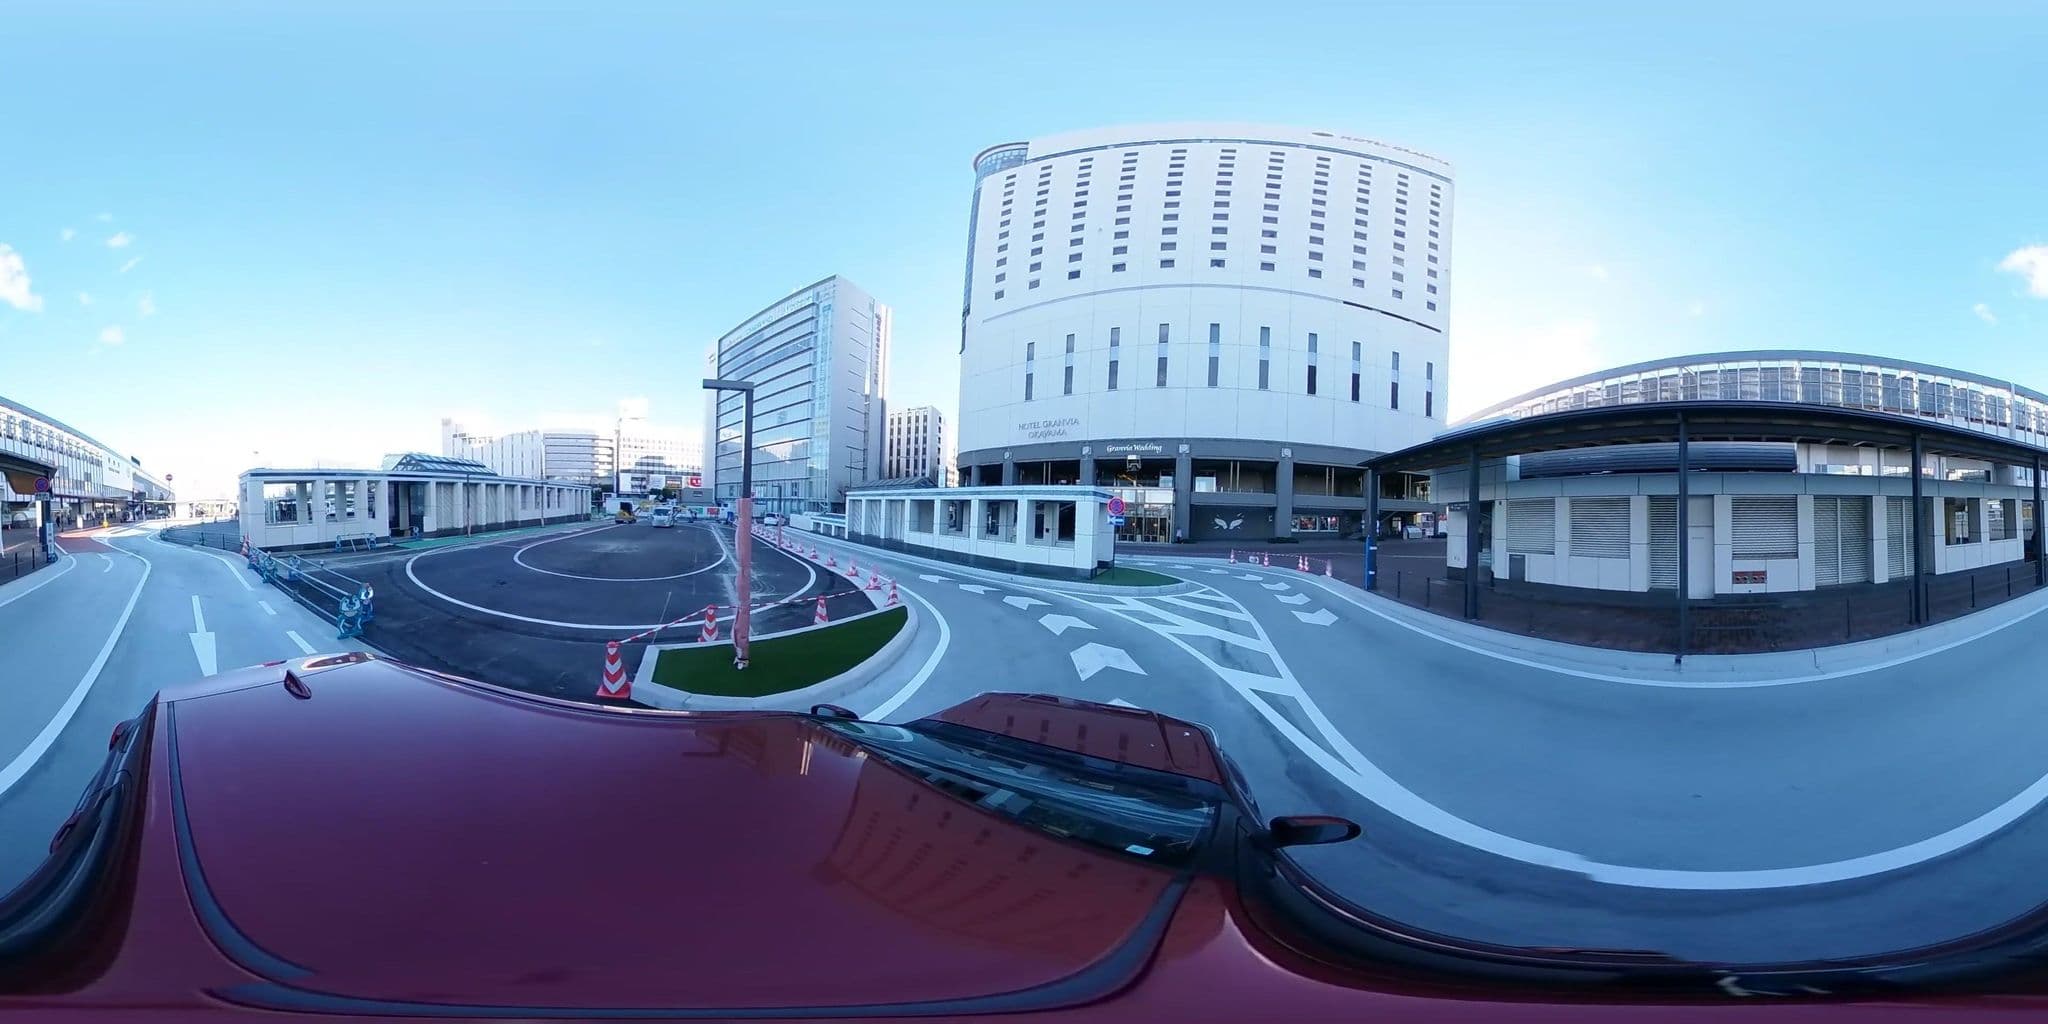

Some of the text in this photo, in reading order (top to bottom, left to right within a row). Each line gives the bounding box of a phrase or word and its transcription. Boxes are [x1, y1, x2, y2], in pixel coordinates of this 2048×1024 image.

[1018, 417, 1080, 431] HOTEL GRANVIA
[1028, 429, 1067, 439] OKAYAMA
[1106, 443, 1163, 454] Granvia Wedding
